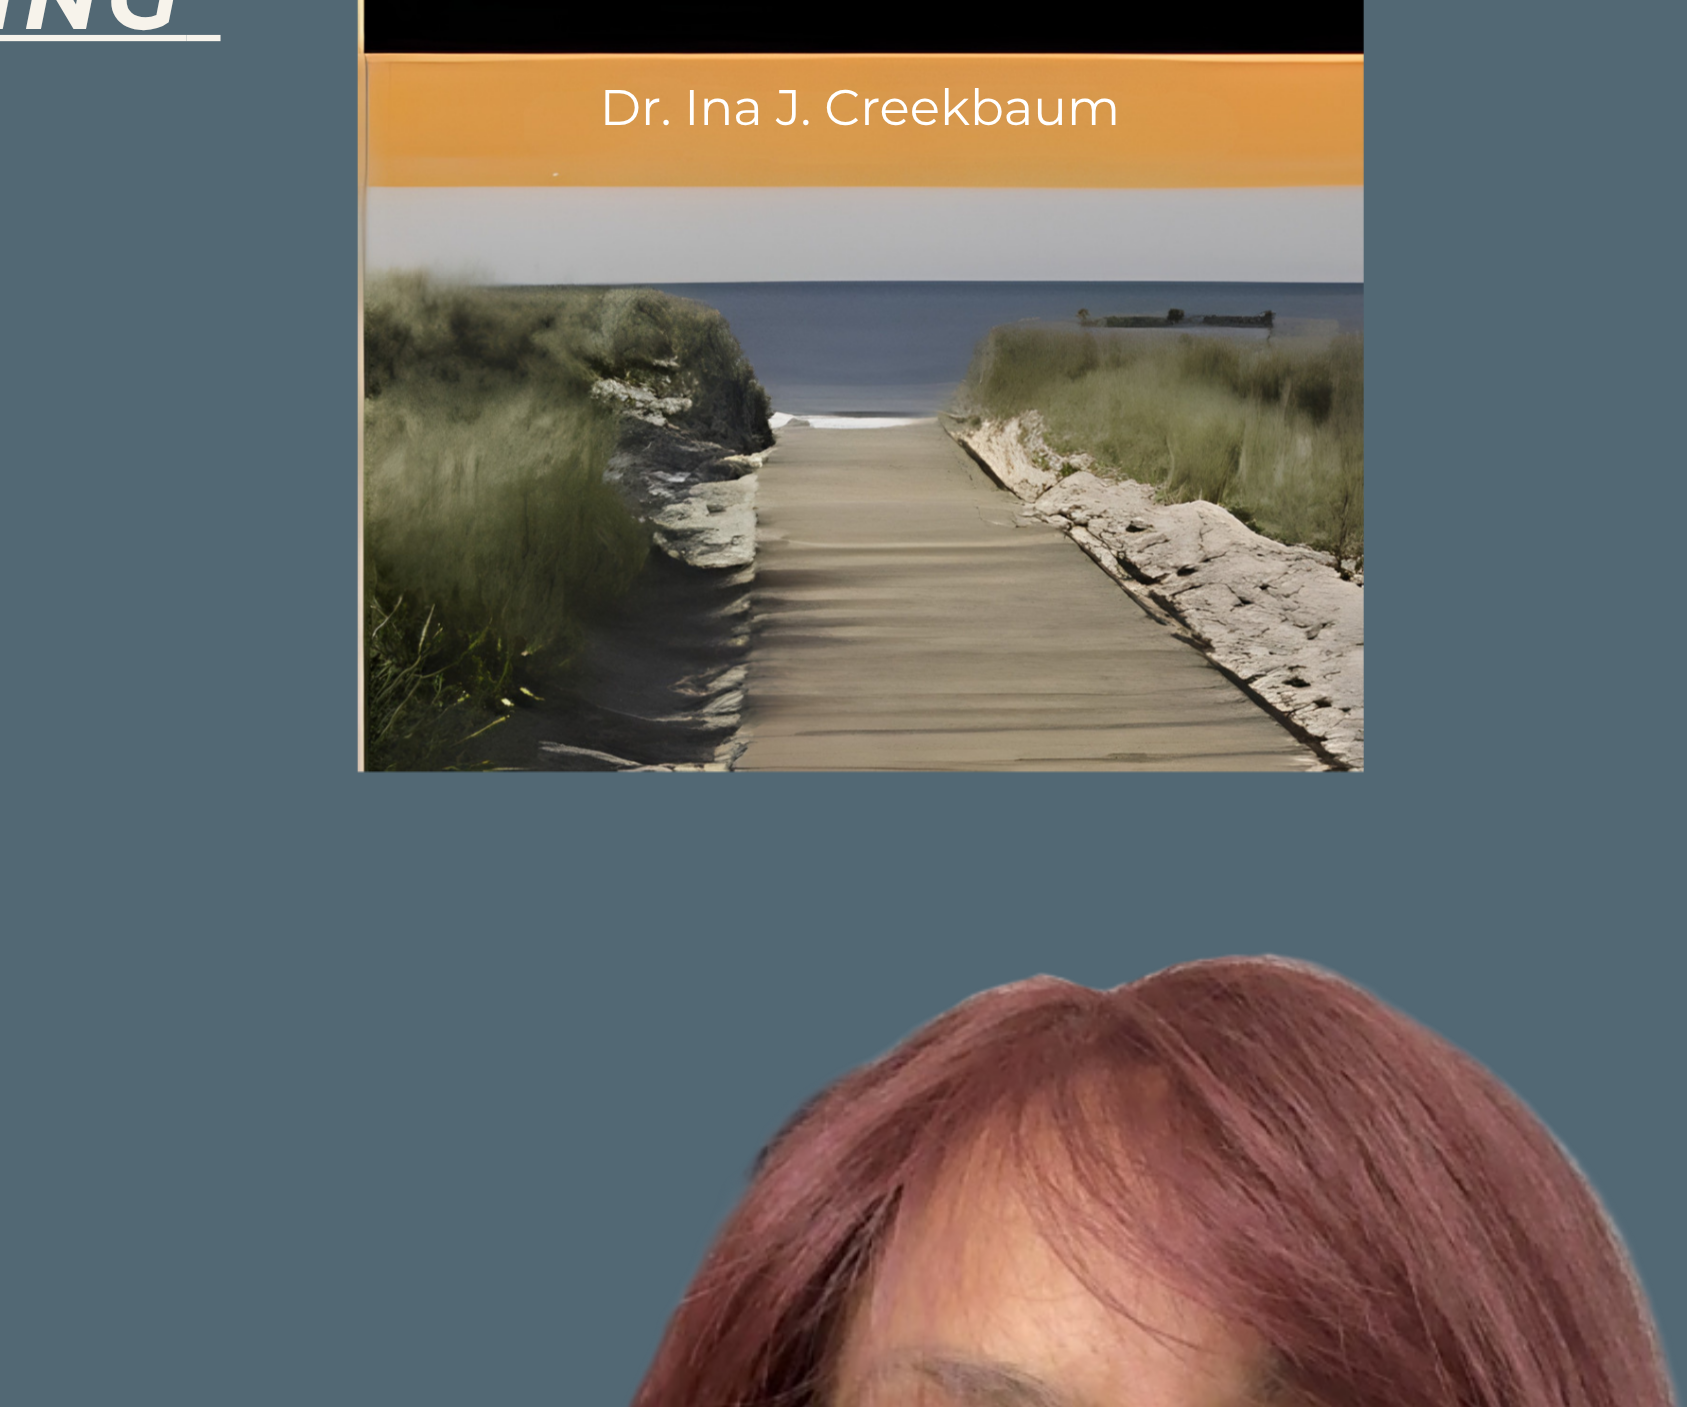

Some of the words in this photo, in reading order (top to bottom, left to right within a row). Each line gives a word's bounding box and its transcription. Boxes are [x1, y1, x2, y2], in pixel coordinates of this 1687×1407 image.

[605, 90, 669, 125] Dr.
[690, 90, 758, 125] Ina
[776, 90, 809, 125] J.
[827, 88, 1116, 125] Creekbaum
